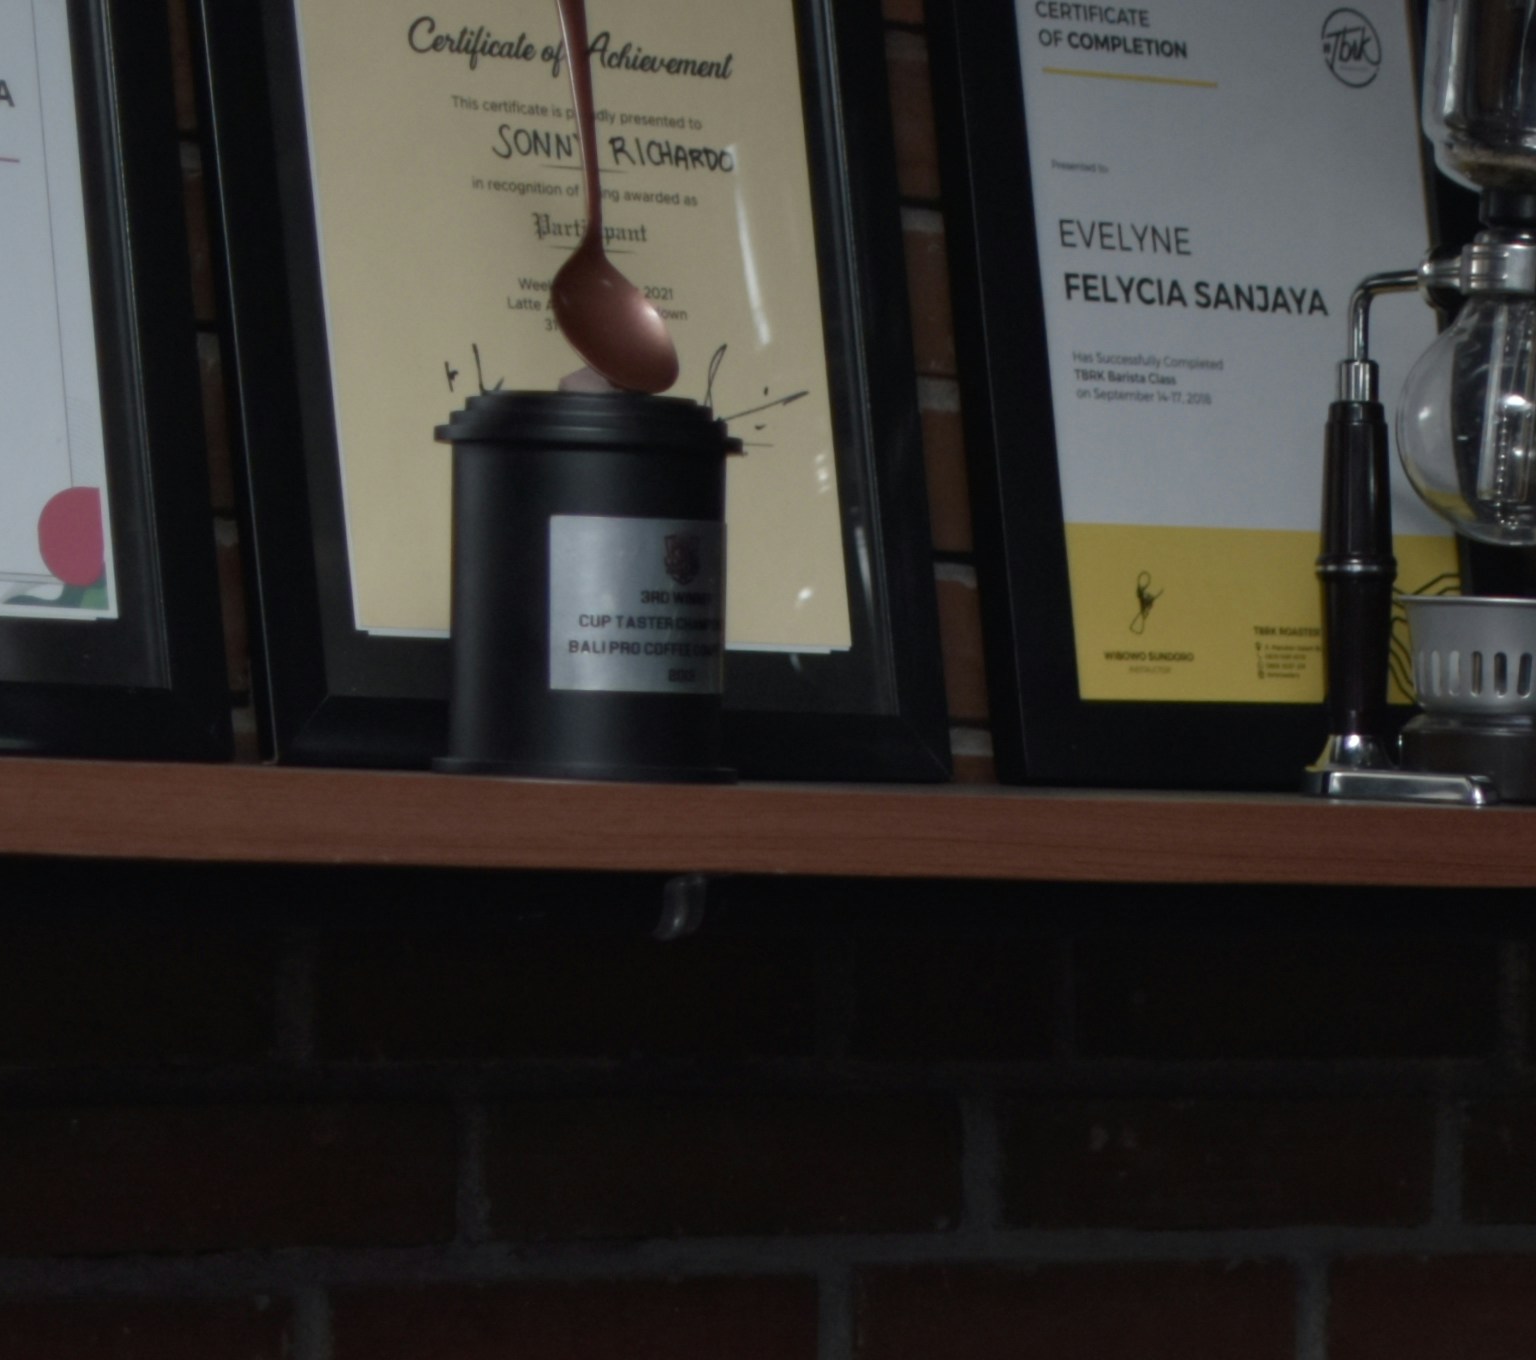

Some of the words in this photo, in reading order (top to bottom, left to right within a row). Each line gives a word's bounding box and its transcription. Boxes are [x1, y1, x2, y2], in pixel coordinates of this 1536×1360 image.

[1034, 0, 1152, 28] CERTIFICATE
[407, 14, 537, 72] Certificate
[541, 38, 566, 81] of
[583, 31, 735, 82] Achievement
[1038, 28, 1064, 48] OF
[1067, 31, 1189, 60] COMPLETION
[451, 94, 480, 112] This
[482, 97, 550, 119] certificate
[551, 103, 563, 119] is
[565, 107, 617, 127] pdly
[619, 111, 686, 132] presented
[688, 115, 704, 131] to
[608, 135, 735, 174] RICHARDO
[471, 176, 485, 190] in
[487, 178, 564, 200] recognition
[565, 184, 580, 198] of
[622, 189, 681, 207] awarded
[683, 193, 699, 208] as
[1058, 218, 1193, 257] EVELYNE
[507, 297, 542, 312] Latte
[643, 286, 674, 301] 2021
[1064, 272, 1188, 310] FELYCIA
[1195, 280, 1330, 318] SANJAYA
[1072, 350, 1094, 364] Has
[1095, 351, 1161, 370] Successfully
[1163, 355, 1225, 372] Completed
[1073, 367, 1105, 382] TBRK
[1107, 369, 1146, 384] Barista
[1148, 372, 1177, 386] Class
[1076, 388, 1091, 400] on
[1093, 387, 1155, 403] September
[640, 590, 670, 605] 3RD
[578, 613, 612, 629] CUP
[617, 615, 674, 631] TASTER
[568, 639, 607, 655] BALI
[609, 641, 641, 656] PRO
